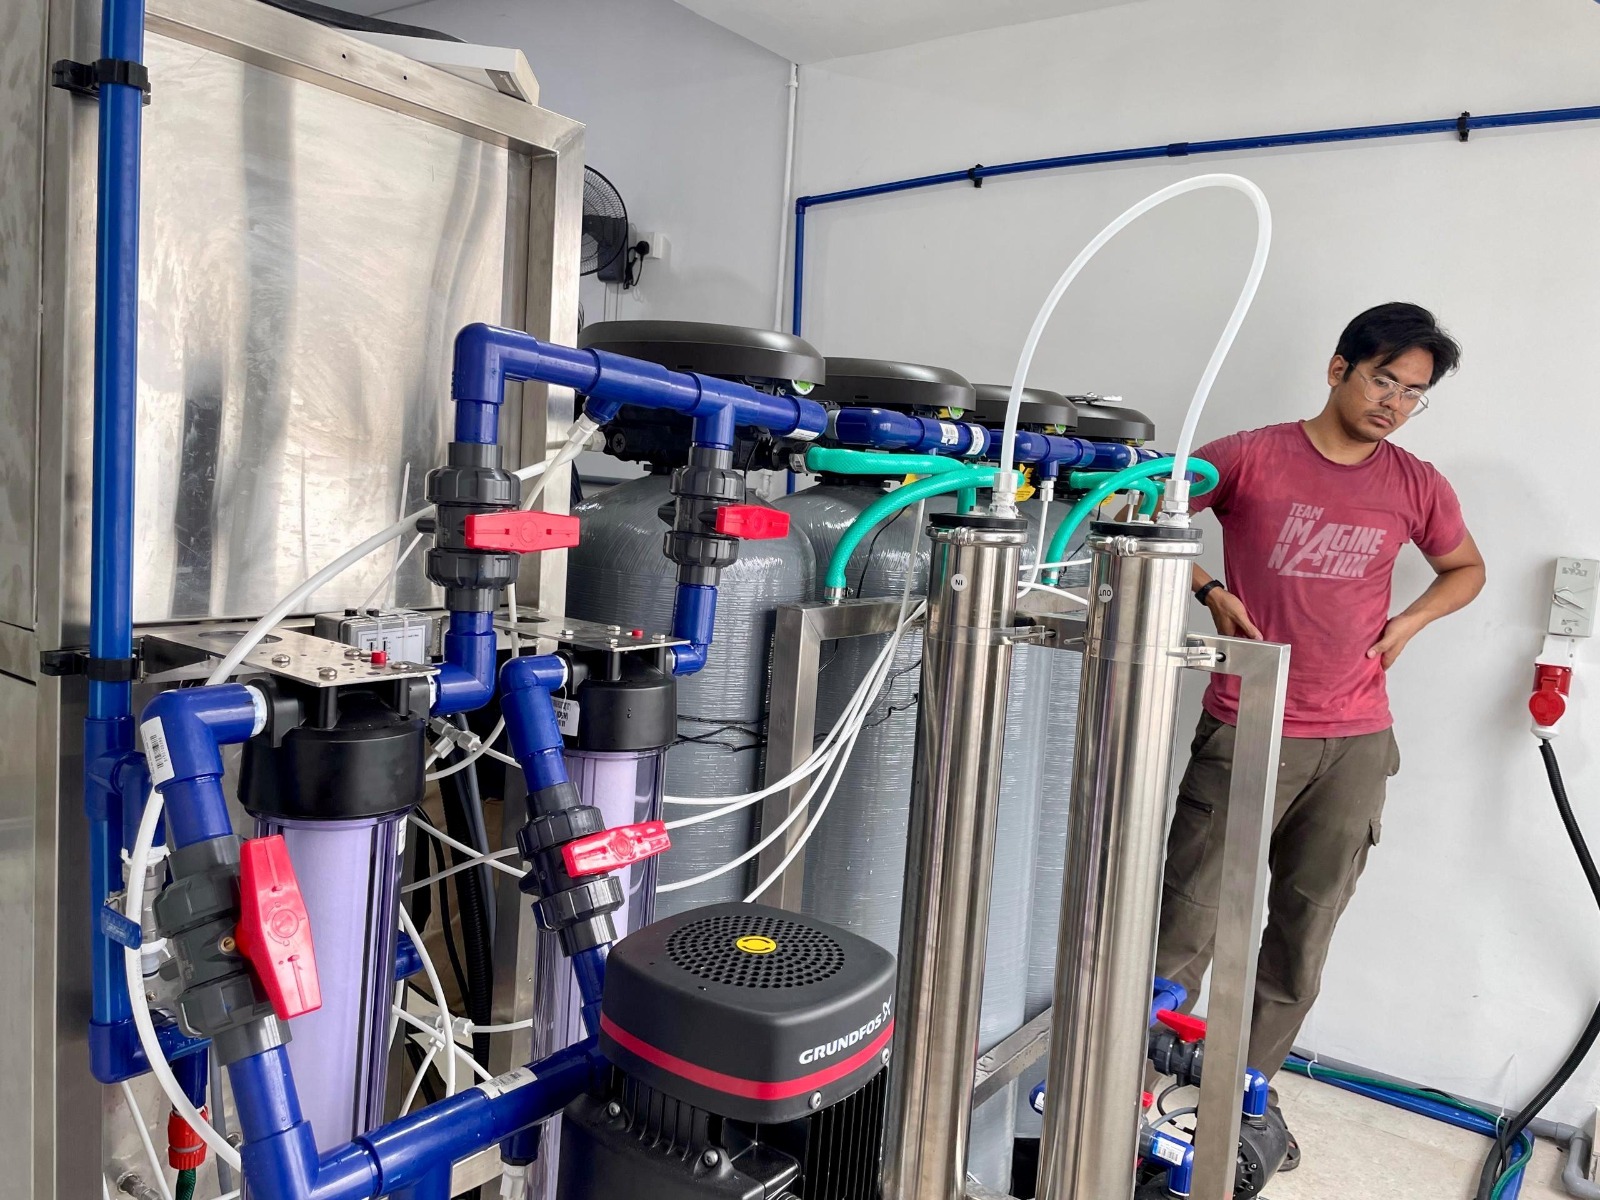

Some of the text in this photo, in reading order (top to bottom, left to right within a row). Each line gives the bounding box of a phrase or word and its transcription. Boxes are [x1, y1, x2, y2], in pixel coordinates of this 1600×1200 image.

[1289, 502, 1325, 521] TEAM
[1276, 515, 1388, 556] IMAGINE
[1267, 541, 1376, 579] NATION
[1099, 589, 1111, 597] OUT
[798, 1012, 883, 1065] GRUNDFOS
